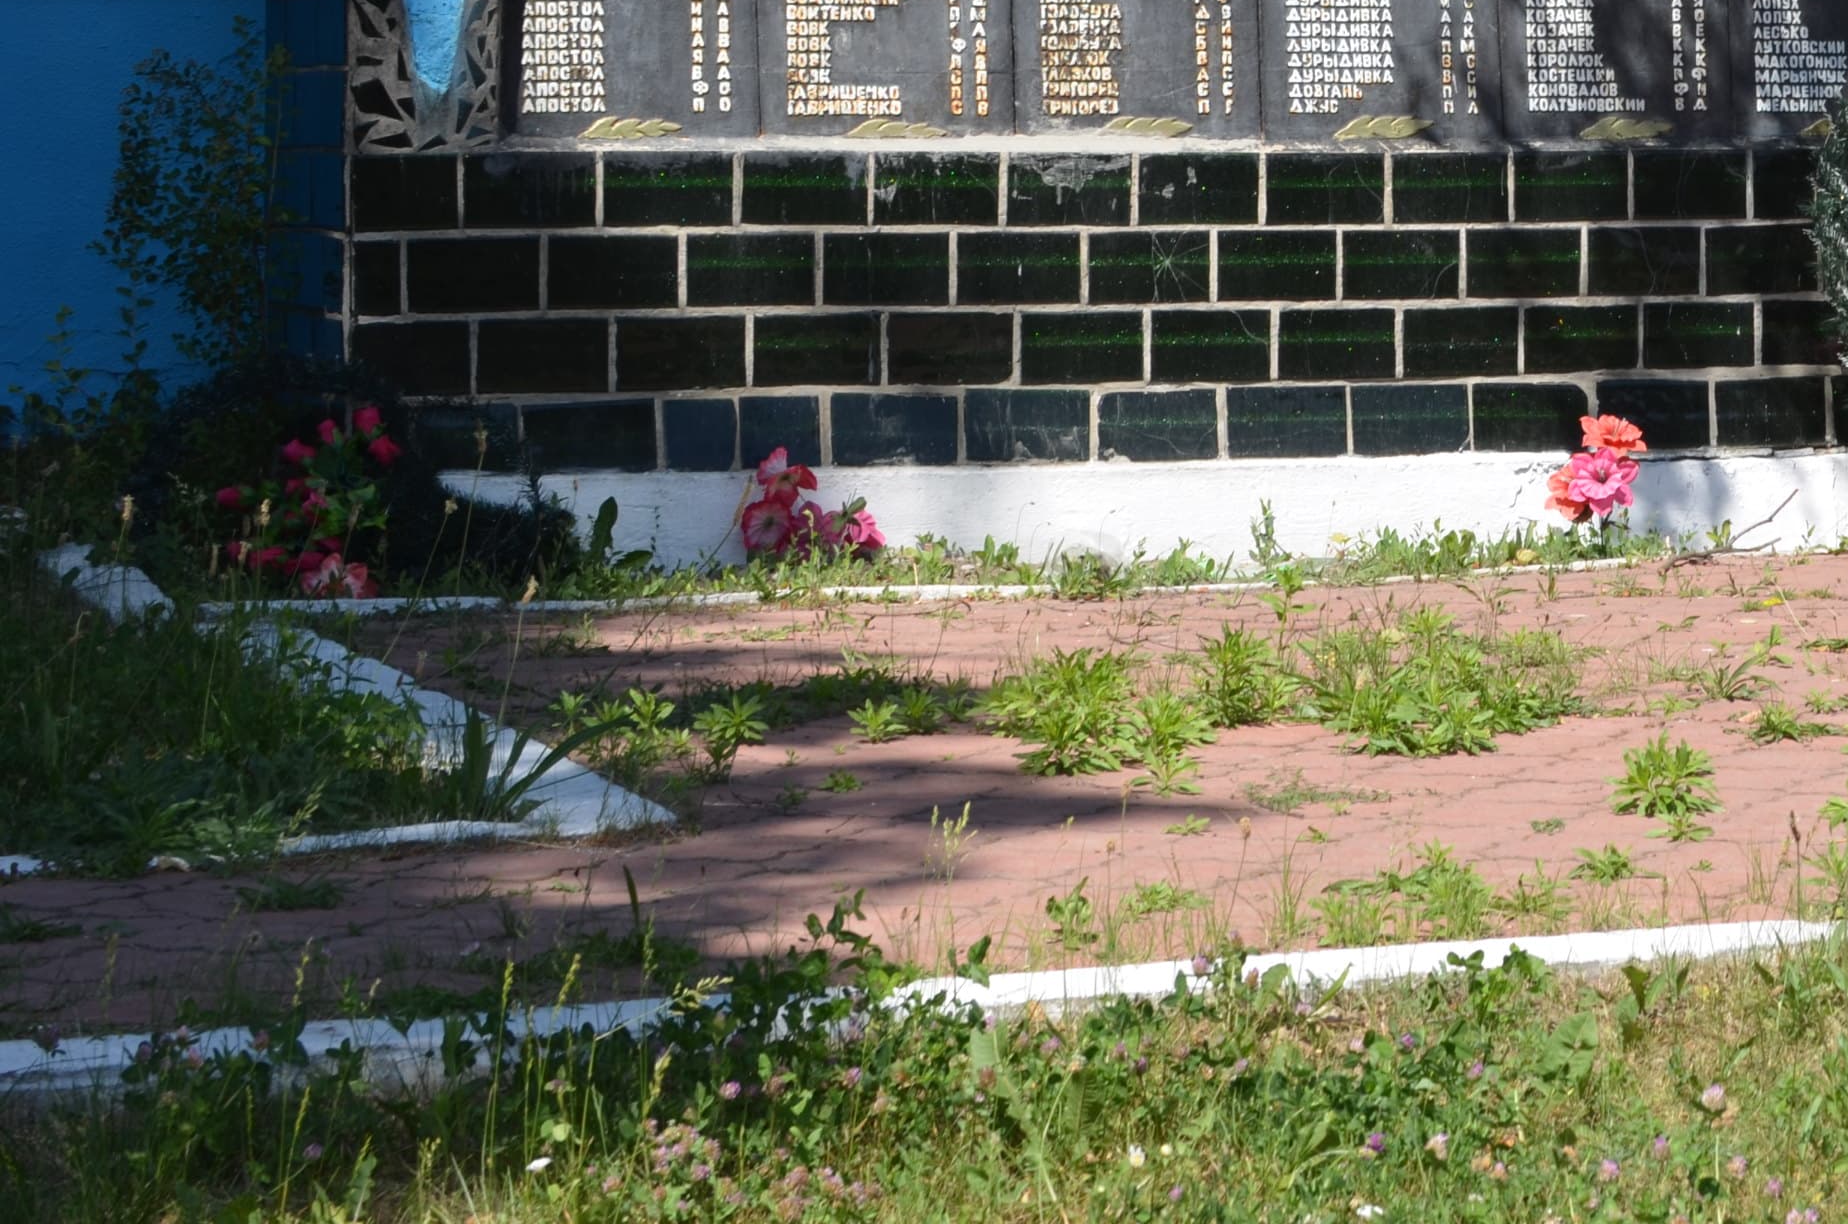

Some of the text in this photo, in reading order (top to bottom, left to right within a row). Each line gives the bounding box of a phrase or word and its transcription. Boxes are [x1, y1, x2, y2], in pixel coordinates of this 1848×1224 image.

[524, 1, 603, 17] АПОСТОЛ
[1286, 8, 1392, 23] ДУРЫДИВКА
[1526, 8, 1592, 23] КОЗАЧЕК
[523, 17, 603, 33] АПОСТОЛ
[1753, 10, 1801, 25] ЛОПУХ
[1287, 23, 1393, 38] ДУРЫДИВКА
[1526, 23, 1594, 38] КОЗАЧЕК
[1754, 25, 1808, 40] ЛЕСЬКО
[523, 33, 603, 49] АПОСТОЛ
[1287, 38, 1391, 53] ДУРЫДИВКА
[1527, 38, 1594, 53] КОЗАЧЕК
[522, 49, 603, 65] АПОСТОЛ
[1288, 53, 1394, 69] ДУРЫДИВКА
[1527, 53, 1603, 68] КОРОЛЮК
[1755, 55, 1847, 70] МАКОГОНЮК
[523, 65, 604, 81] АПОСТОЛ
[1289, 69, 1394, 84] ДУРЫДИВКА
[1755, 70, 1846, 84] МАРЬЯНЧУК
[523, 81, 604, 97] АПОСТОЛ
[1290, 84, 1362, 99] ДОВГАНЬ
[1528, 83, 1617, 98] КОНОВАЛОВ
[1756, 84, 1842, 99] МАРЦЕНЮК
[523, 97, 606, 113] АПОСТОЛ
[1757, 99, 1826, 113] МЕЛЬНИК
